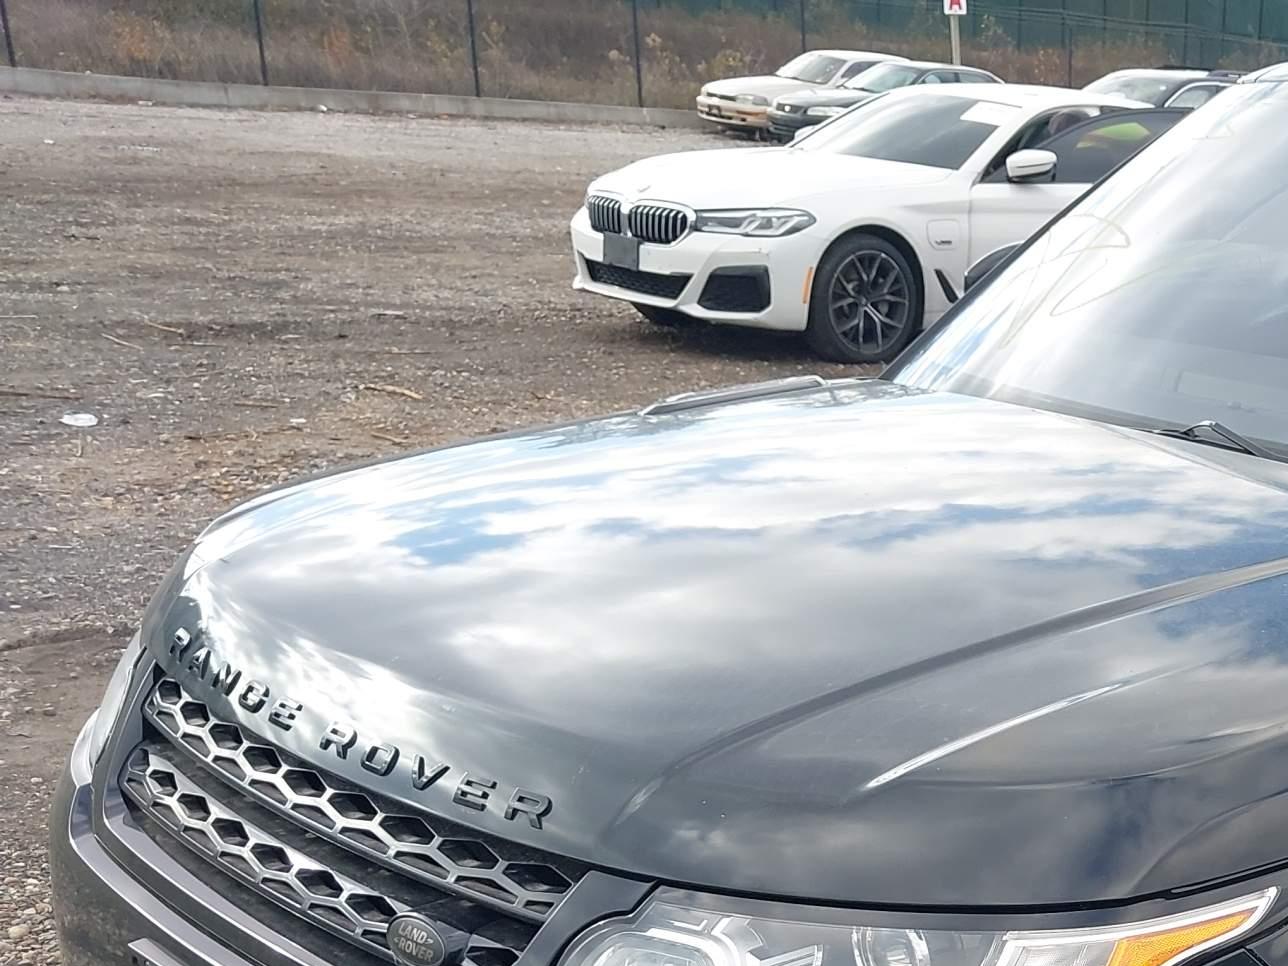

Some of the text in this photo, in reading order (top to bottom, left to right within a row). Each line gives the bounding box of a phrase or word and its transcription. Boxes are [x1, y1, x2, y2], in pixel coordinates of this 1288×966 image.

[168, 626, 553, 830] RANGE ROVER
[398, 921, 428, 945] LAND
[398, 937, 434, 962] ROVER
